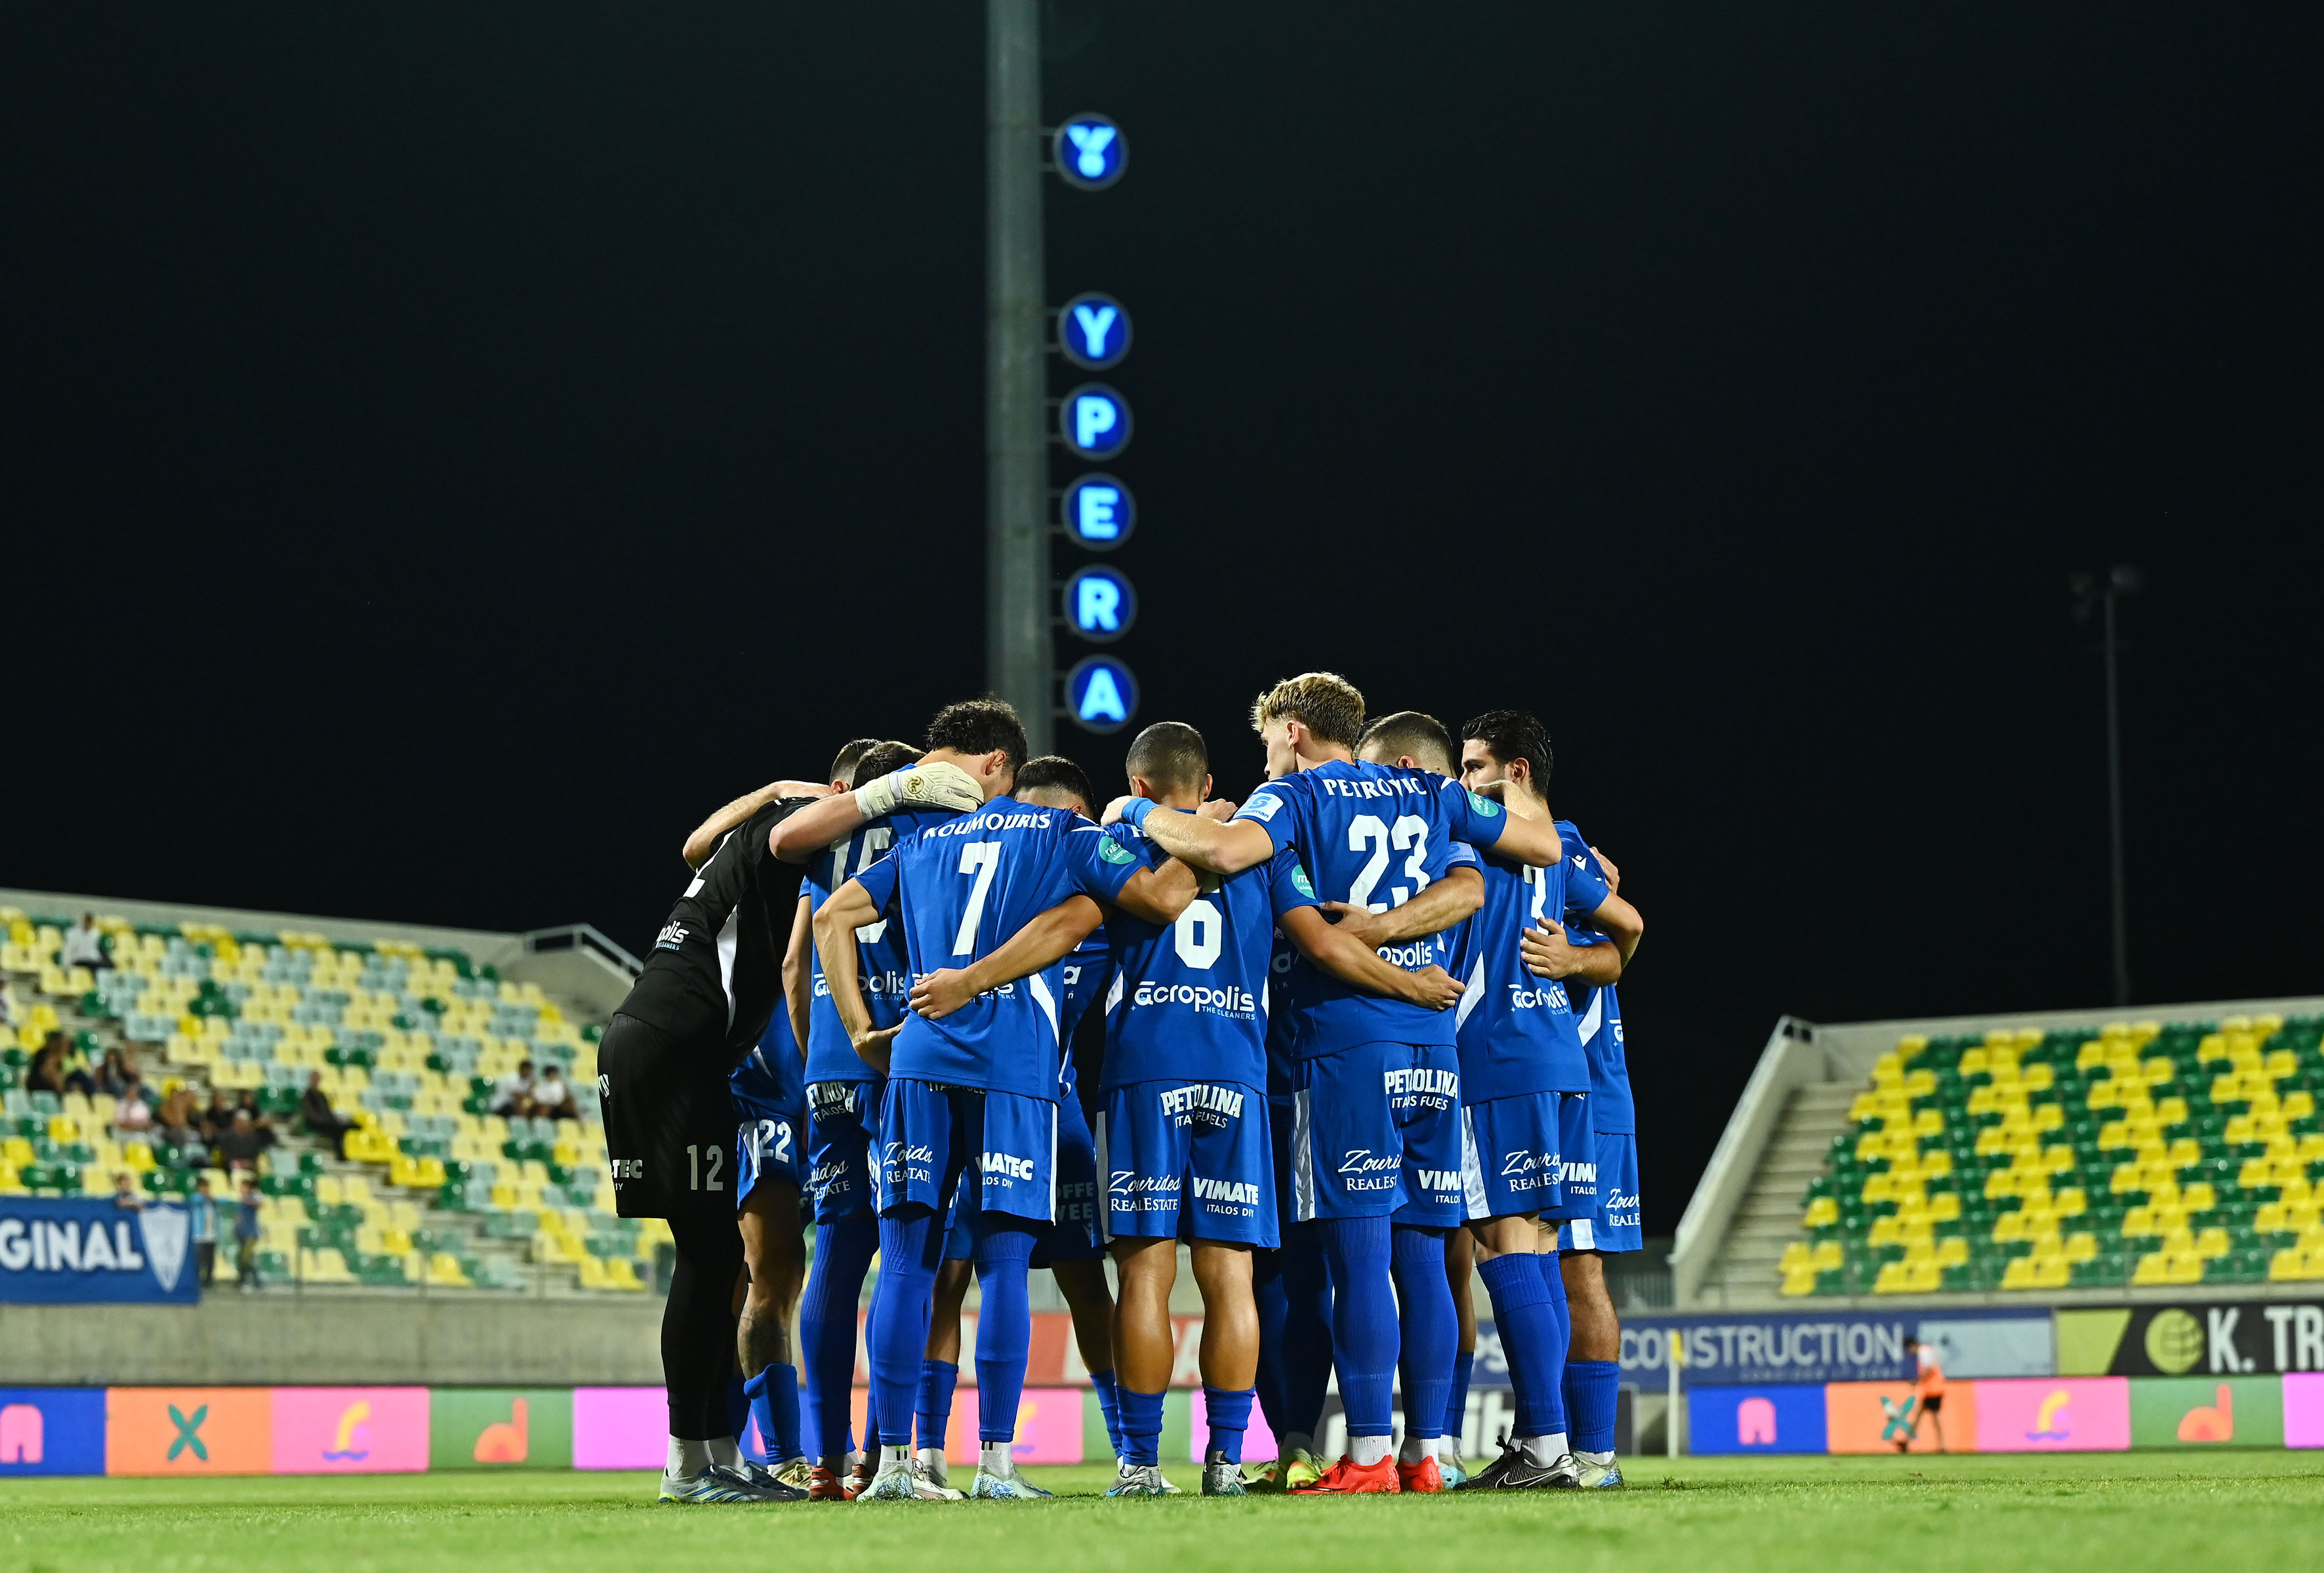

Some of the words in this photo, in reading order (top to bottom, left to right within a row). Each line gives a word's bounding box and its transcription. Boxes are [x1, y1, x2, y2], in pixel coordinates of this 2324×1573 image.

[1322, 777, 1427, 800] PETROVIC
[923, 813, 1051, 840] KOUMOURIS
[1348, 814, 1431, 914] 23
[952, 841, 1002, 956] 7
[1202, 1006, 1215, 1014] THE
[1217, 1009, 1255, 1021] CLEANERS
[813, 1105, 846, 1122] ITALOS
[759, 1119, 792, 1164] 22
[687, 1144, 724, 1191] 12
[1002, 1178, 1013, 1190] DIY
[1107, 1170, 1181, 1196] Zourides
[1206, 1204, 1238, 1216] ITALOS
[1242, 1208, 1254, 1218] DIY
[2207, 1307, 2256, 1373] K.
